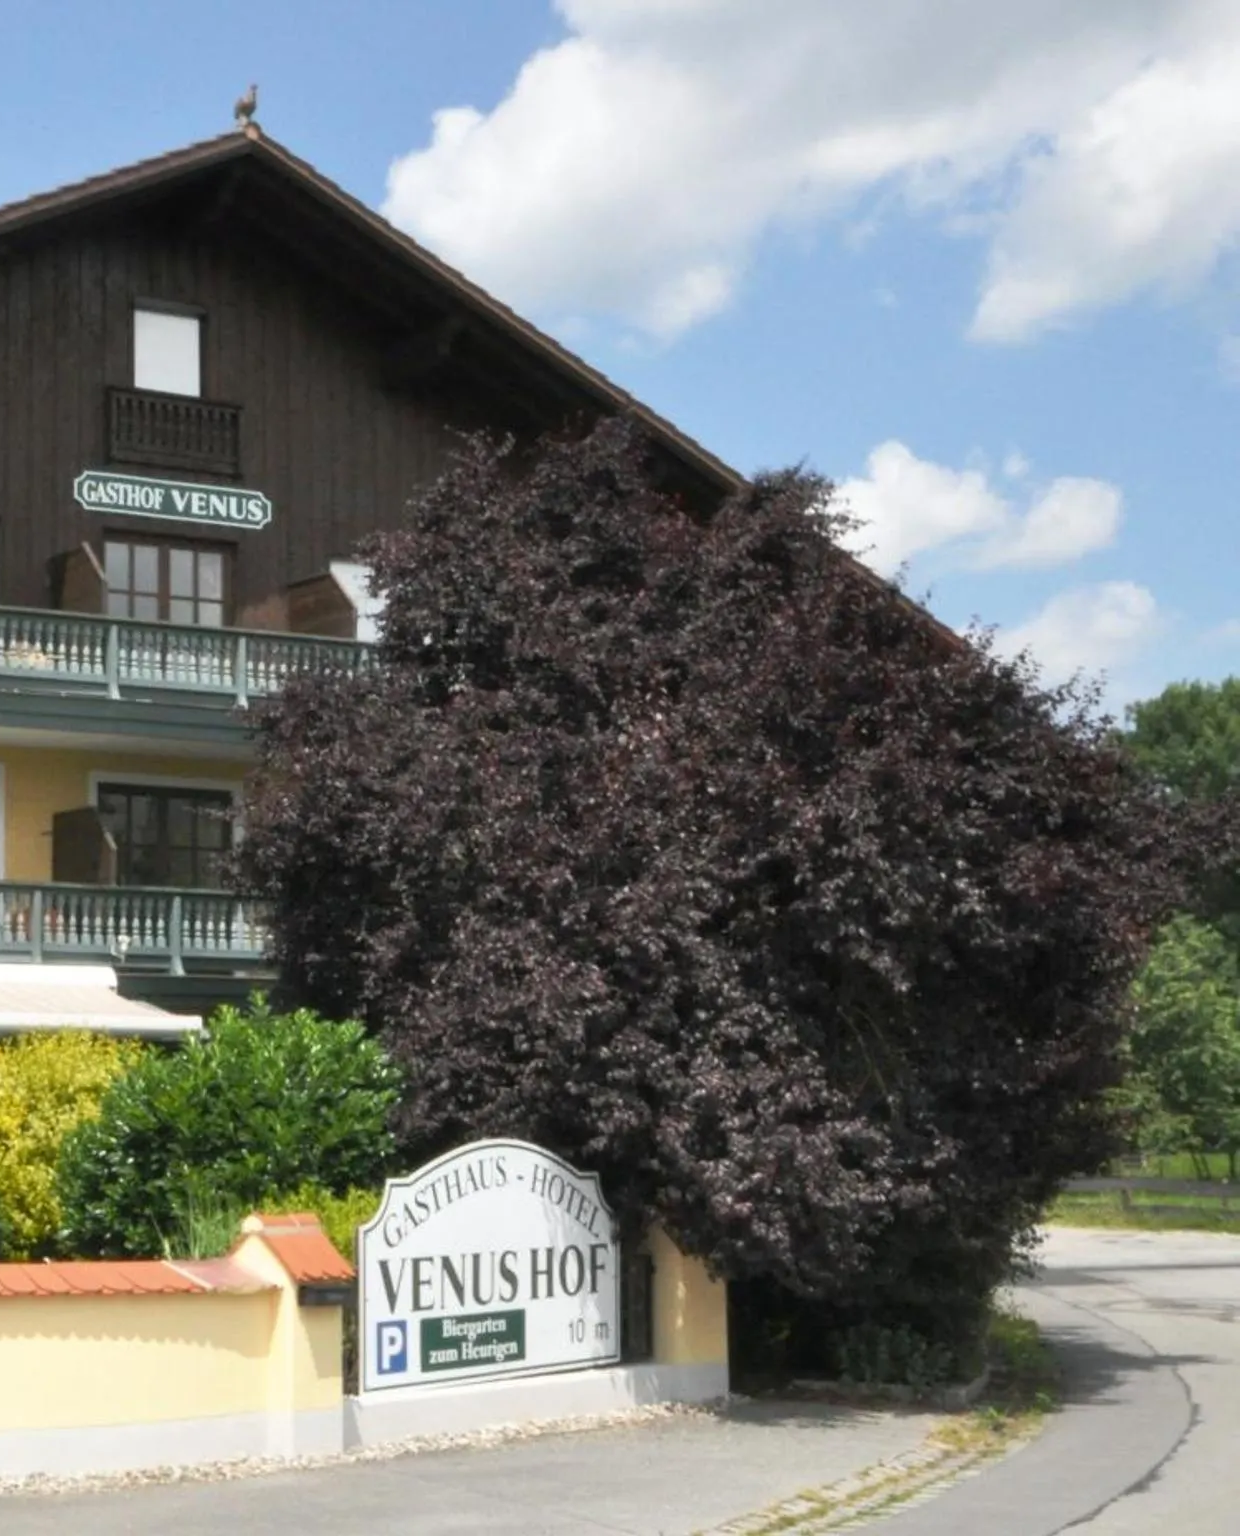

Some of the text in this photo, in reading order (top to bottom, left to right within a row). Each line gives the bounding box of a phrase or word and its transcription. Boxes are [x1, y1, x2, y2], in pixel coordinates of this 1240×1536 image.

[82, 479, 263, 521] GASTHOF VENUS
[382, 1156, 509, 1248] GASTHAUS
[531, 1163, 600, 1238] HOTEL
[442, 1317, 507, 1339] Biergarten
[568, 1318, 586, 1343] 10
[381, 1326, 403, 1370] P
[429, 1339, 518, 1364] zum Heurigen
